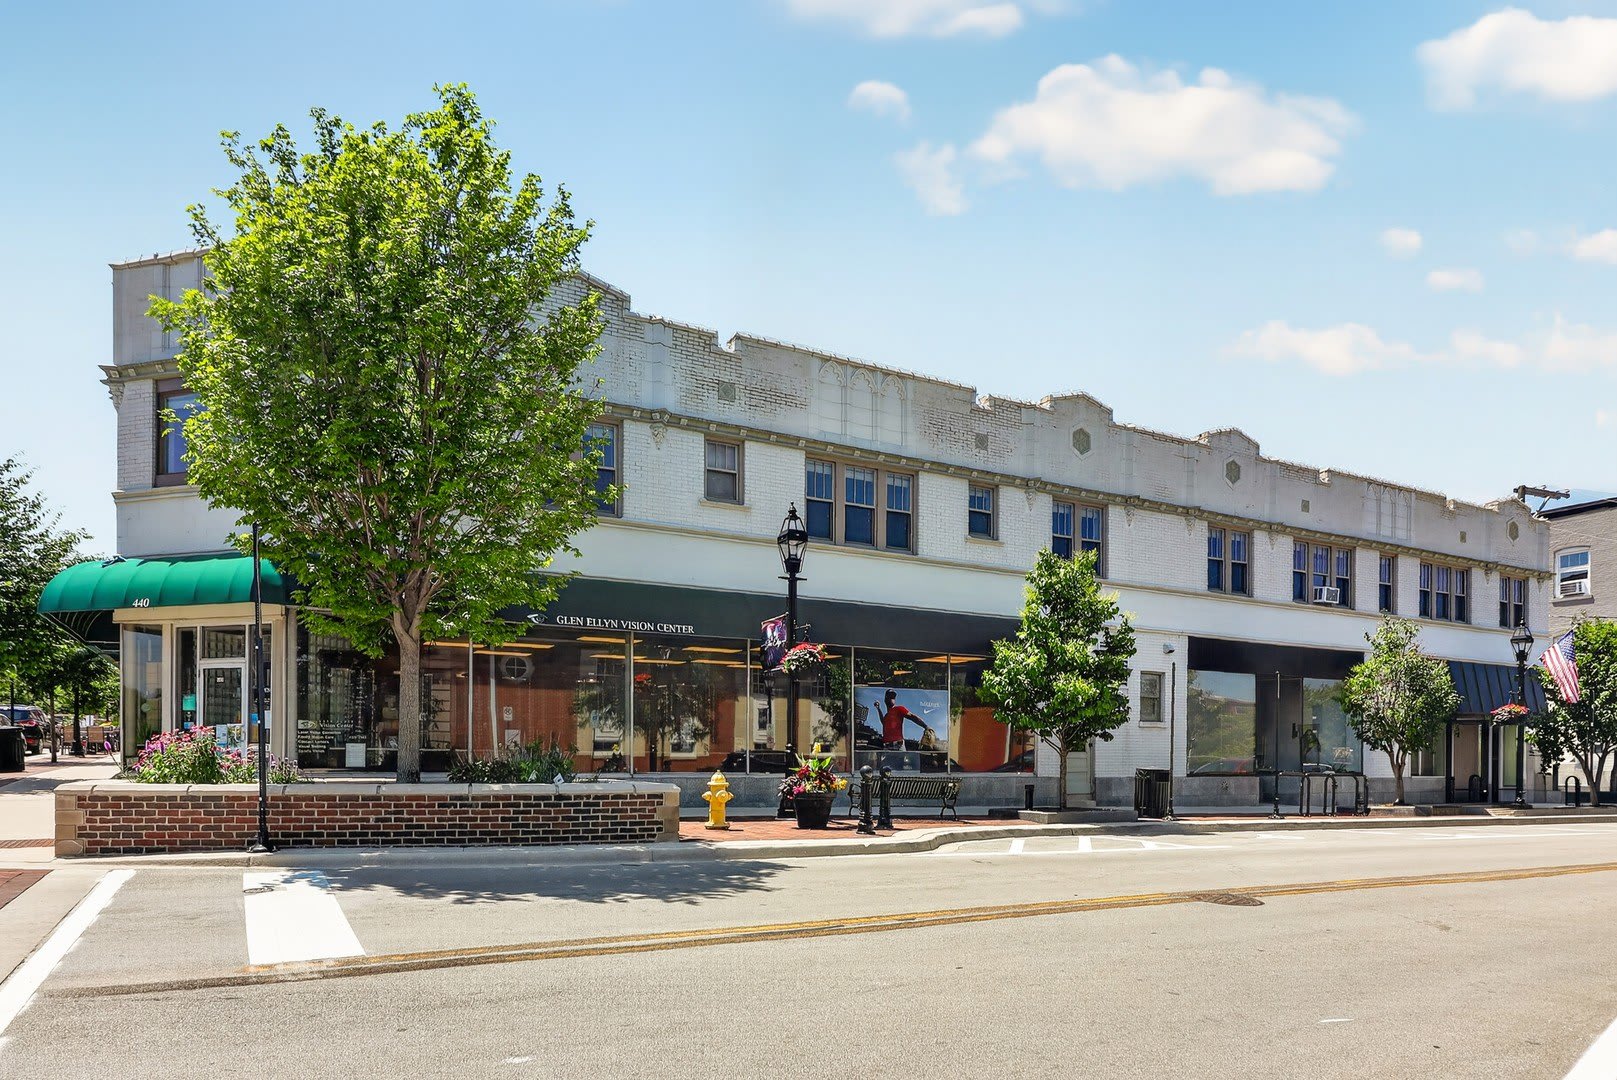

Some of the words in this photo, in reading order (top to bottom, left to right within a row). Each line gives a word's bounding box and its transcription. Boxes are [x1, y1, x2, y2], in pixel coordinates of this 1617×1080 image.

[132, 598, 150, 608] 440
[556, 615, 583, 626] GLEN
[586, 617, 618, 628] ELLYN
[621, 620, 655, 631] VISION
[657, 623, 694, 634] CENTER
